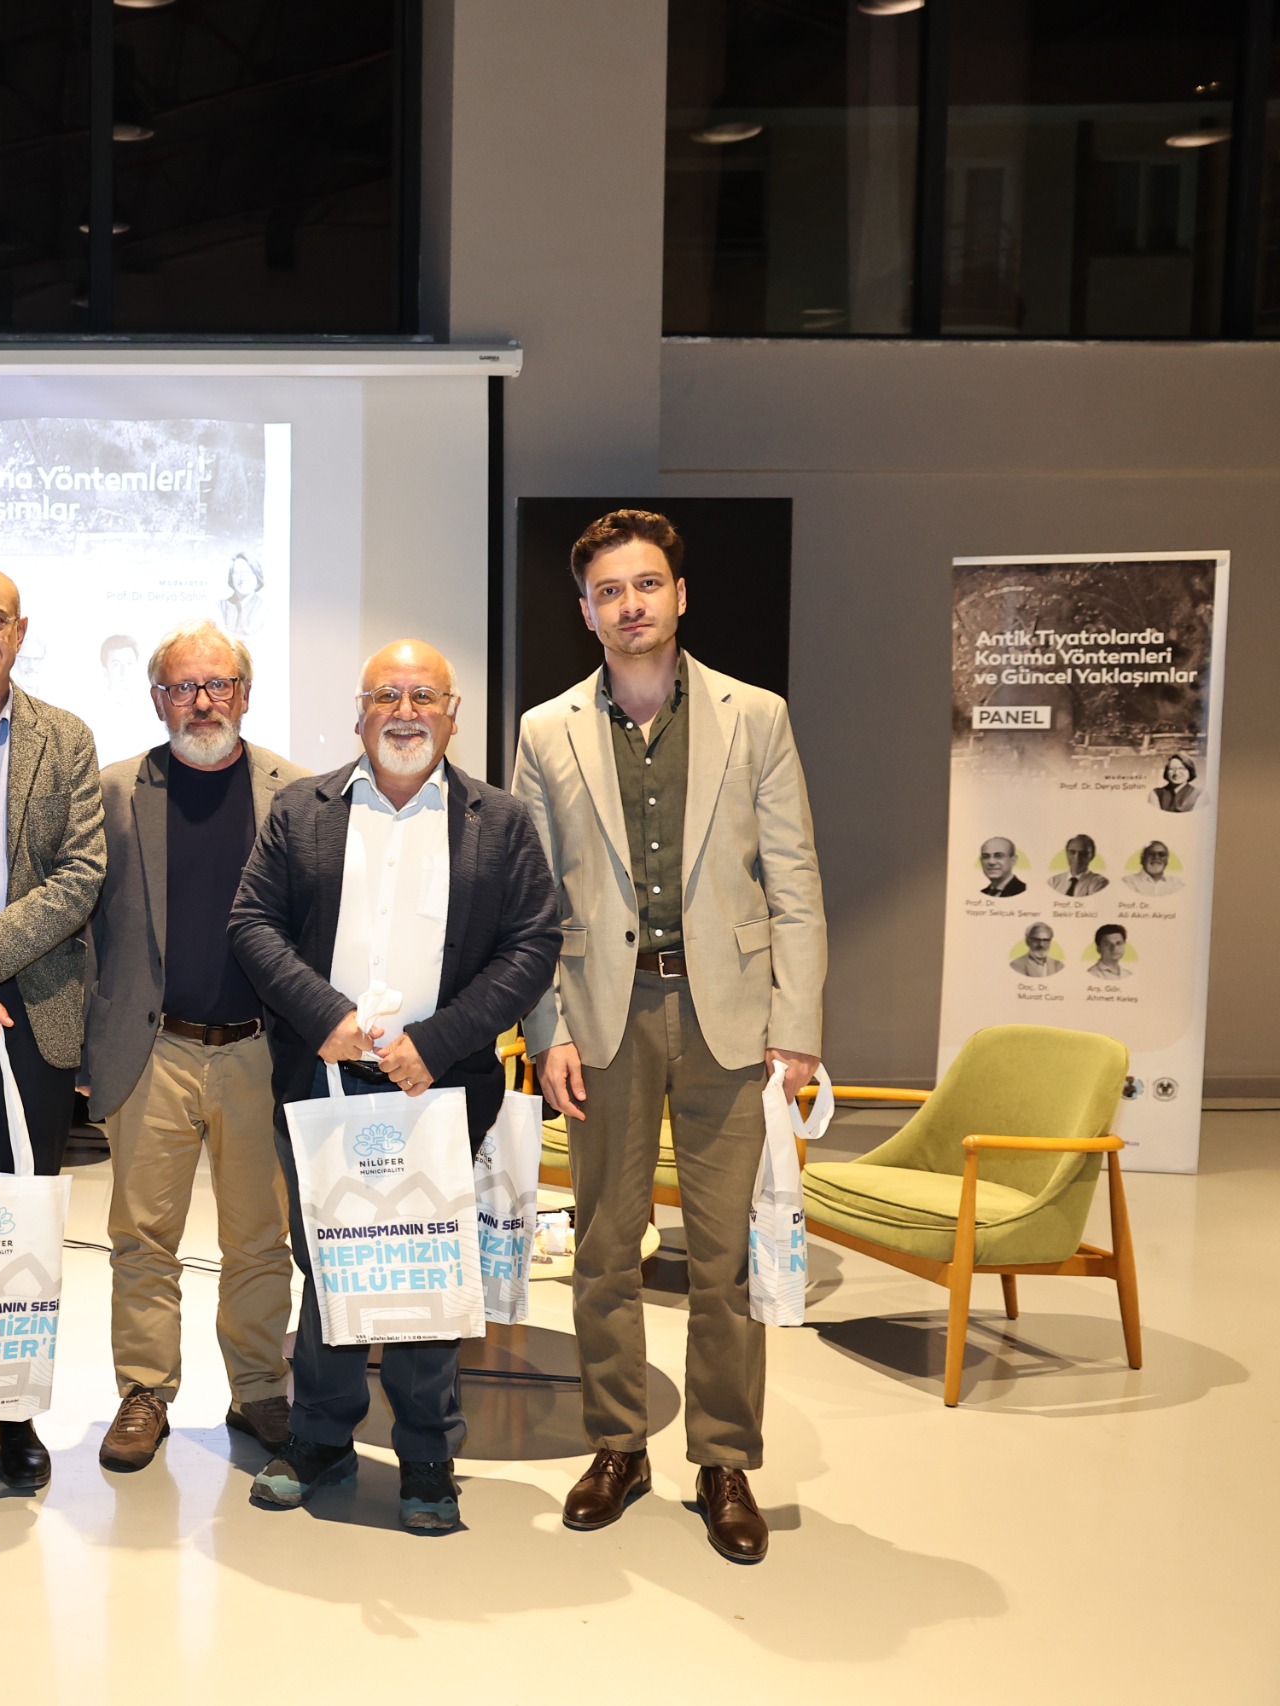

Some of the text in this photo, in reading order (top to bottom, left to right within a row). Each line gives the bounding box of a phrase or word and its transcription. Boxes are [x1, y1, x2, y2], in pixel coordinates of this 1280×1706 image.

[37, 462, 194, 491] Yöntemleri
[975, 628, 1164, 650] Antik Tiyatrolarda
[975, 648, 1173, 666] Koruma Yöntemleri
[974, 667, 1198, 688] ve Güncel Yaklaşımlar
[979, 710, 1044, 725] PANEL
[317, 1223, 424, 1240] DAYANIŞMANIN
